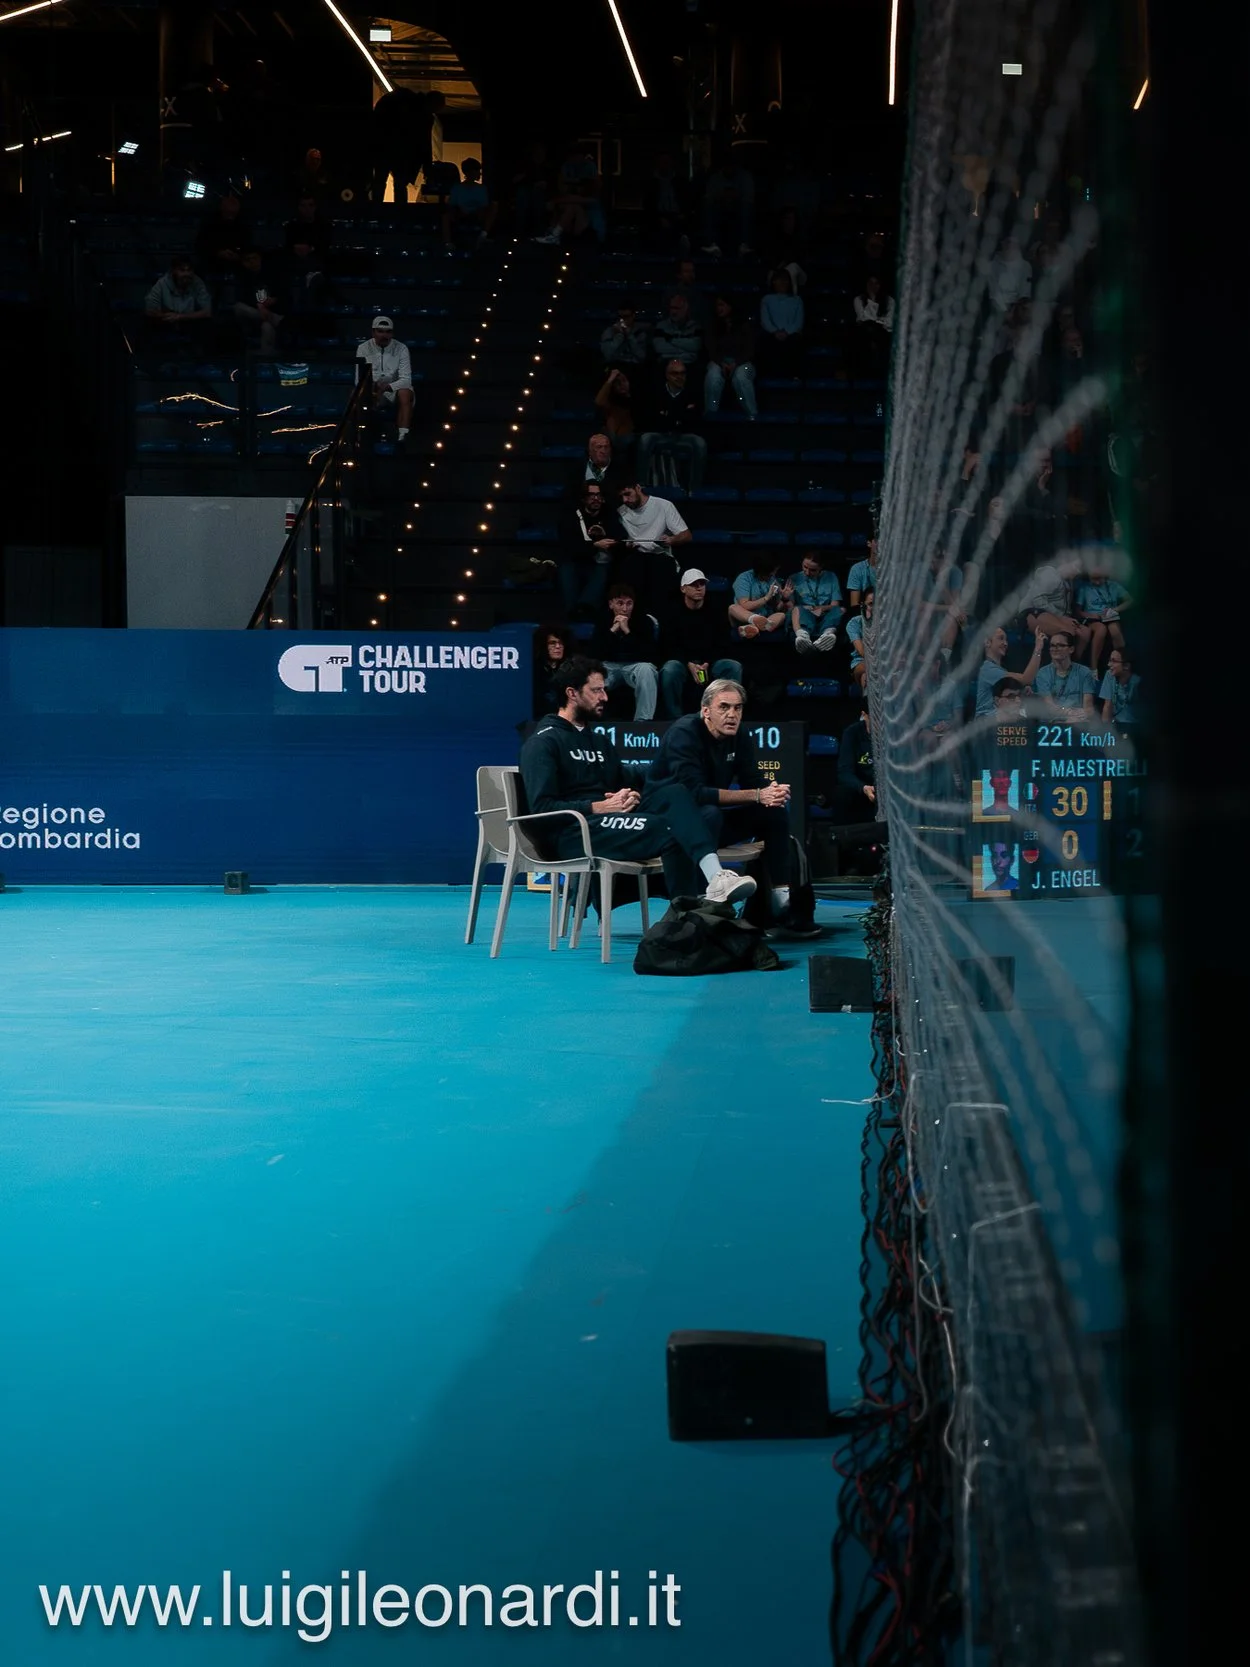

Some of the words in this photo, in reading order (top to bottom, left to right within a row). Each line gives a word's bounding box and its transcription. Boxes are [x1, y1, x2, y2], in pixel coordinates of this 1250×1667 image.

[325, 656, 349, 664] ATP
[358, 645, 519, 669] CHALLENGER
[359, 670, 426, 693] TOUR
[624, 732, 660, 748] Km/h
[997, 727, 1027, 736] SERVE
[997, 737, 1027, 746] SPEED
[1037, 726, 1073, 747] 221
[1080, 732, 1116, 748] Km/h
[758, 760, 781, 770] SEED
[1031, 759, 1046, 777] F.
[1051, 786, 1089, 817] 30
[0, 803, 105, 830] egione
[1061, 829, 1079, 860] 0
[1031, 871, 1046, 889] J.
[1051, 869, 1101, 888] ENGEL
